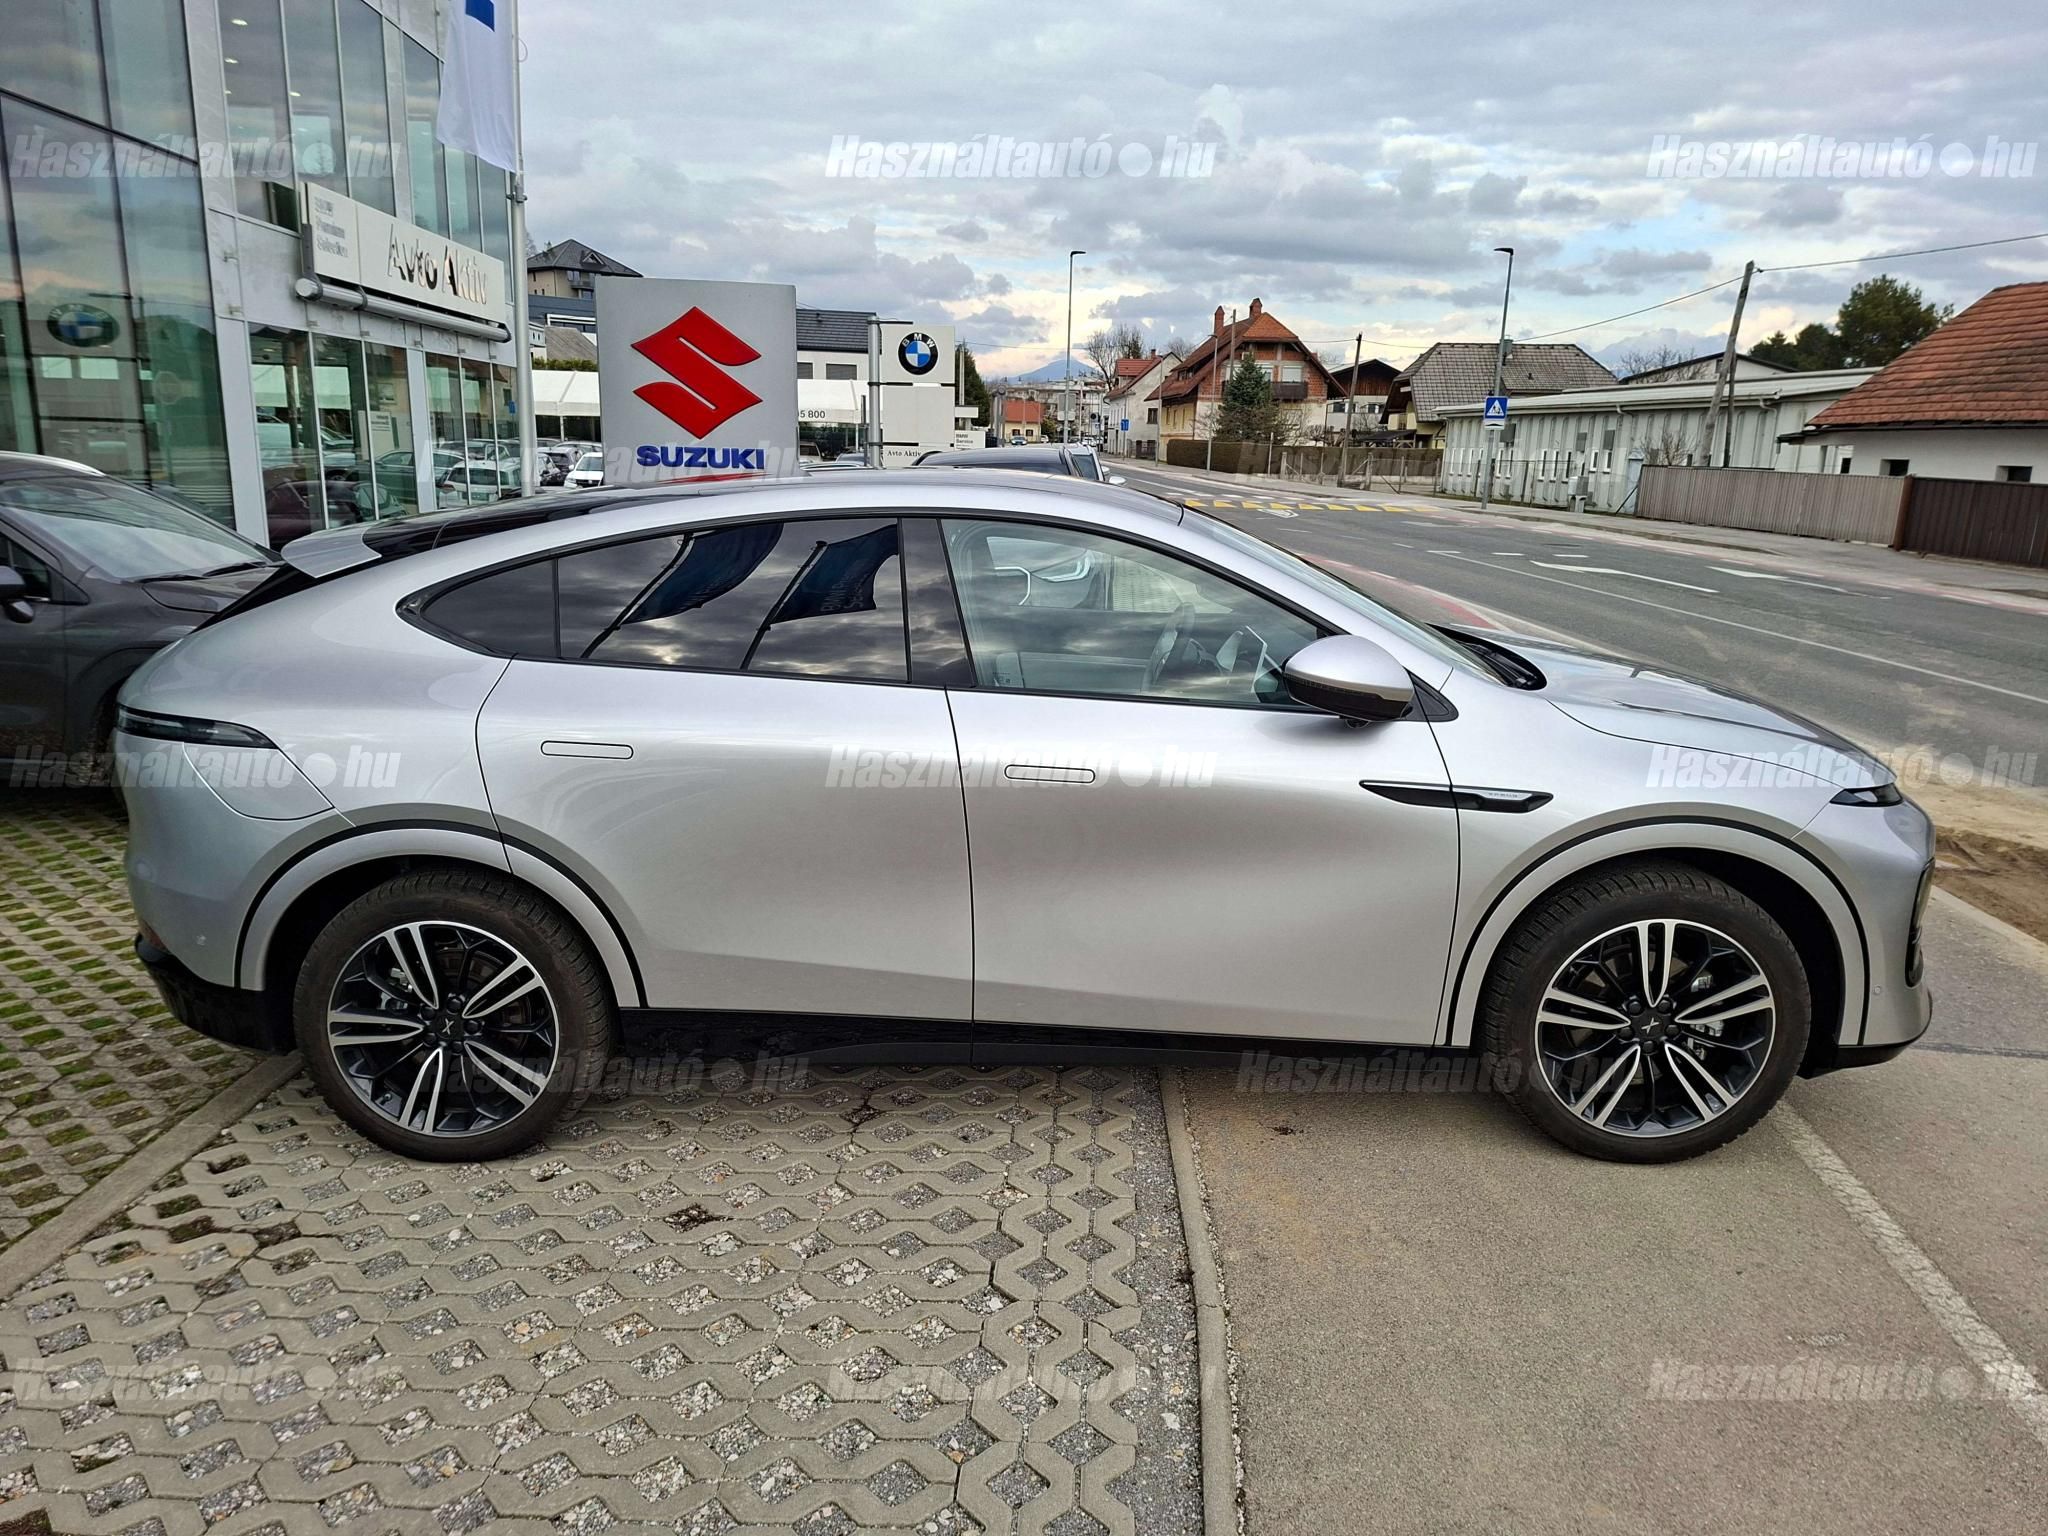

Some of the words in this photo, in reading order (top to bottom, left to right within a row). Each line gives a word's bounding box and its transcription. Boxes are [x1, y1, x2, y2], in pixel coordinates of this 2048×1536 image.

[901, 333, 935, 348] BMW
[808, 410, 825, 418] 800
[636, 445, 765, 470] SUZUKI
